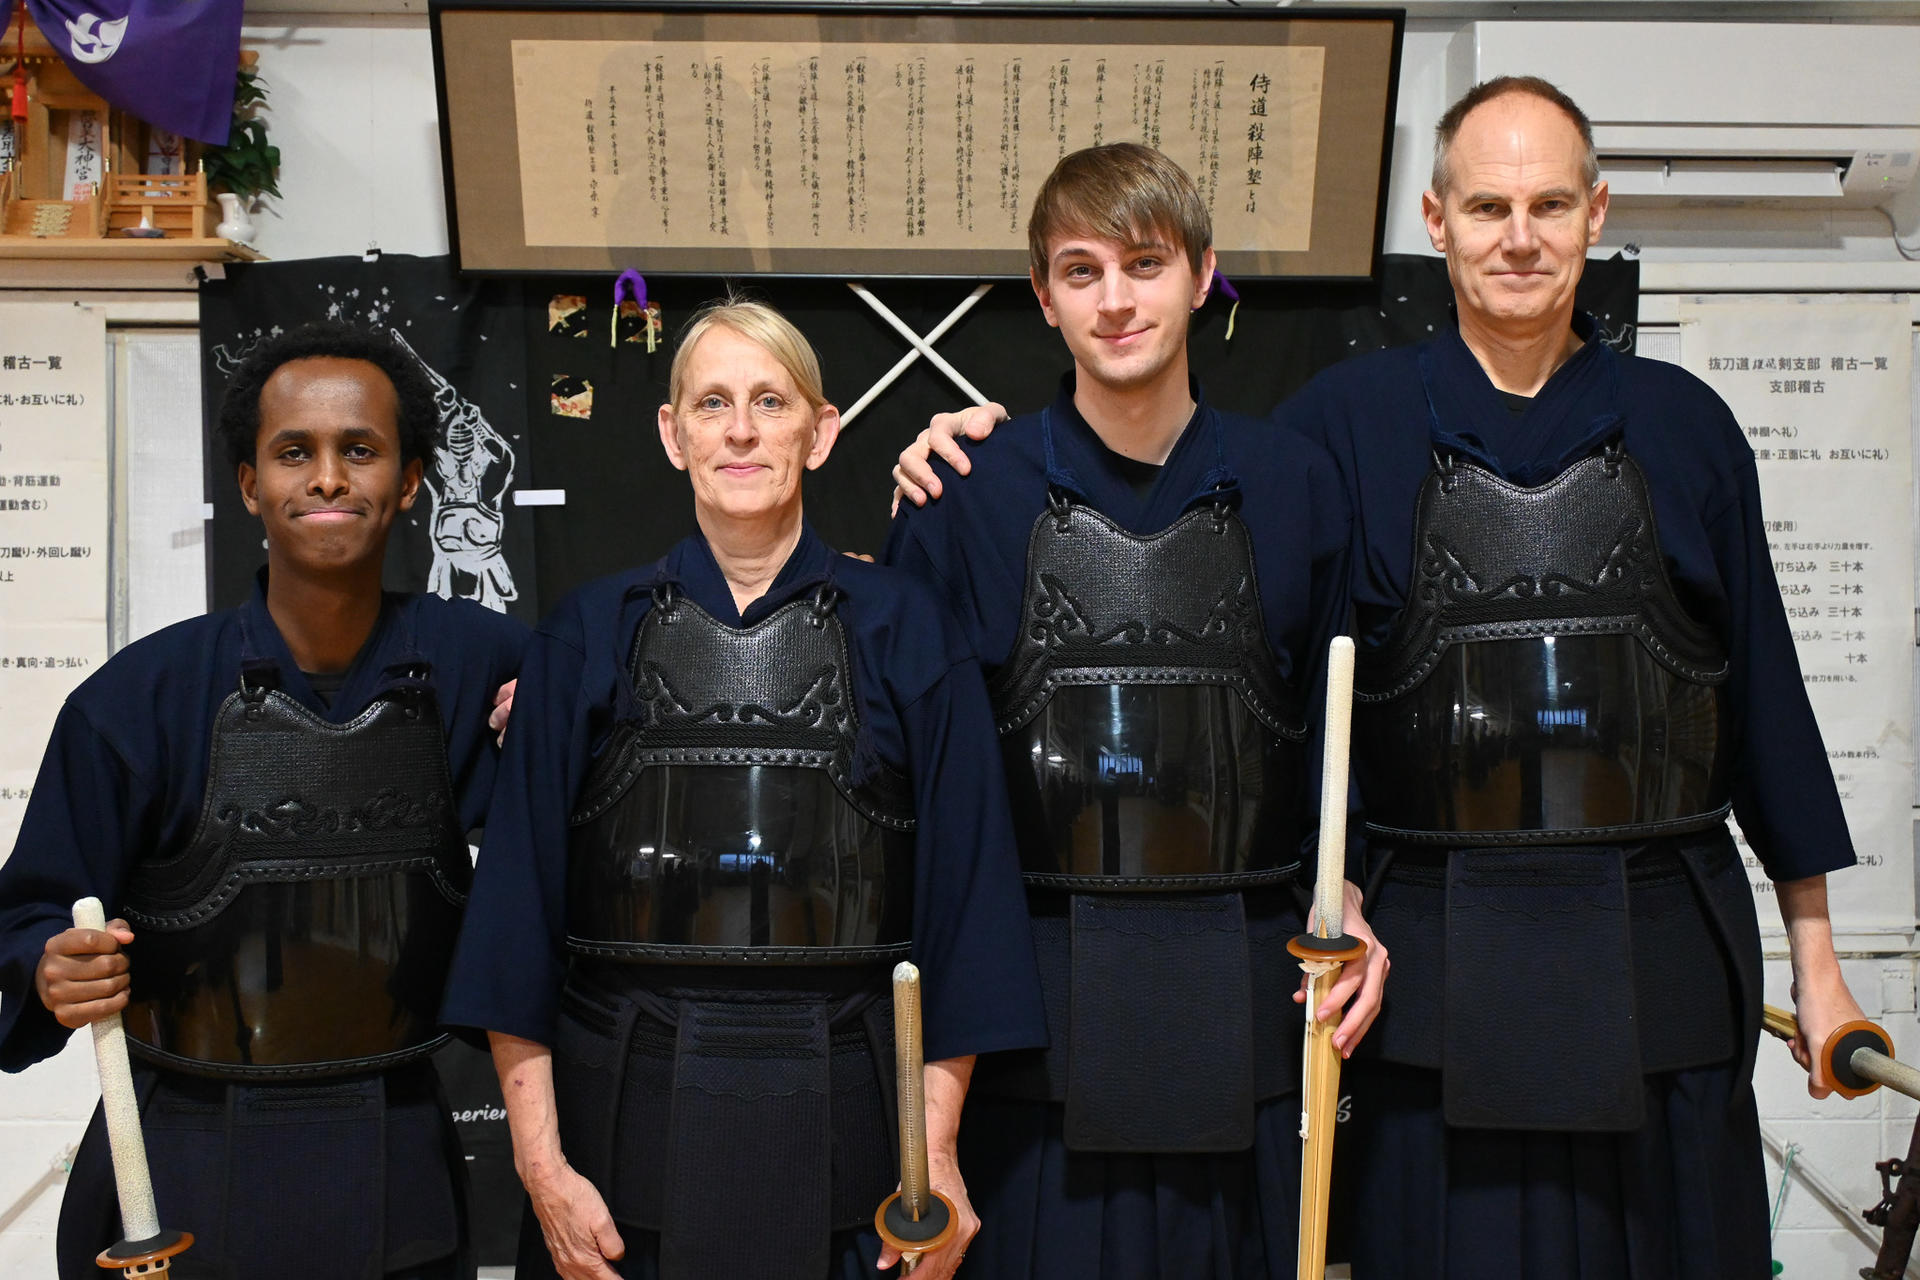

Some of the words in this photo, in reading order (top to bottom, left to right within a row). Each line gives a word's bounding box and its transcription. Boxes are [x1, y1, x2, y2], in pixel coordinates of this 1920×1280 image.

[1246, 73, 1271, 213] 侍道殺陣塾とは
[3, 355, 62, 370] 稽古一覧
[1830, 356, 1889, 371] 稽古一覧
[1769, 380, 1825, 394] 支部稽古
[1774, 560, 1817, 573] 打ち込み
[1829, 561, 1864, 573] 三十本
[1780, 584, 1812, 596] ち込み
[1829, 584, 1864, 595] 二十本
[1784, 606, 1820, 618] ち込み
[1827, 606, 1863, 618] 三十本
[1830, 630, 1866, 642] 二十本
[0, 657, 88, 669] き・真向・追っ払い
[1844, 652, 1868, 664] 十本
